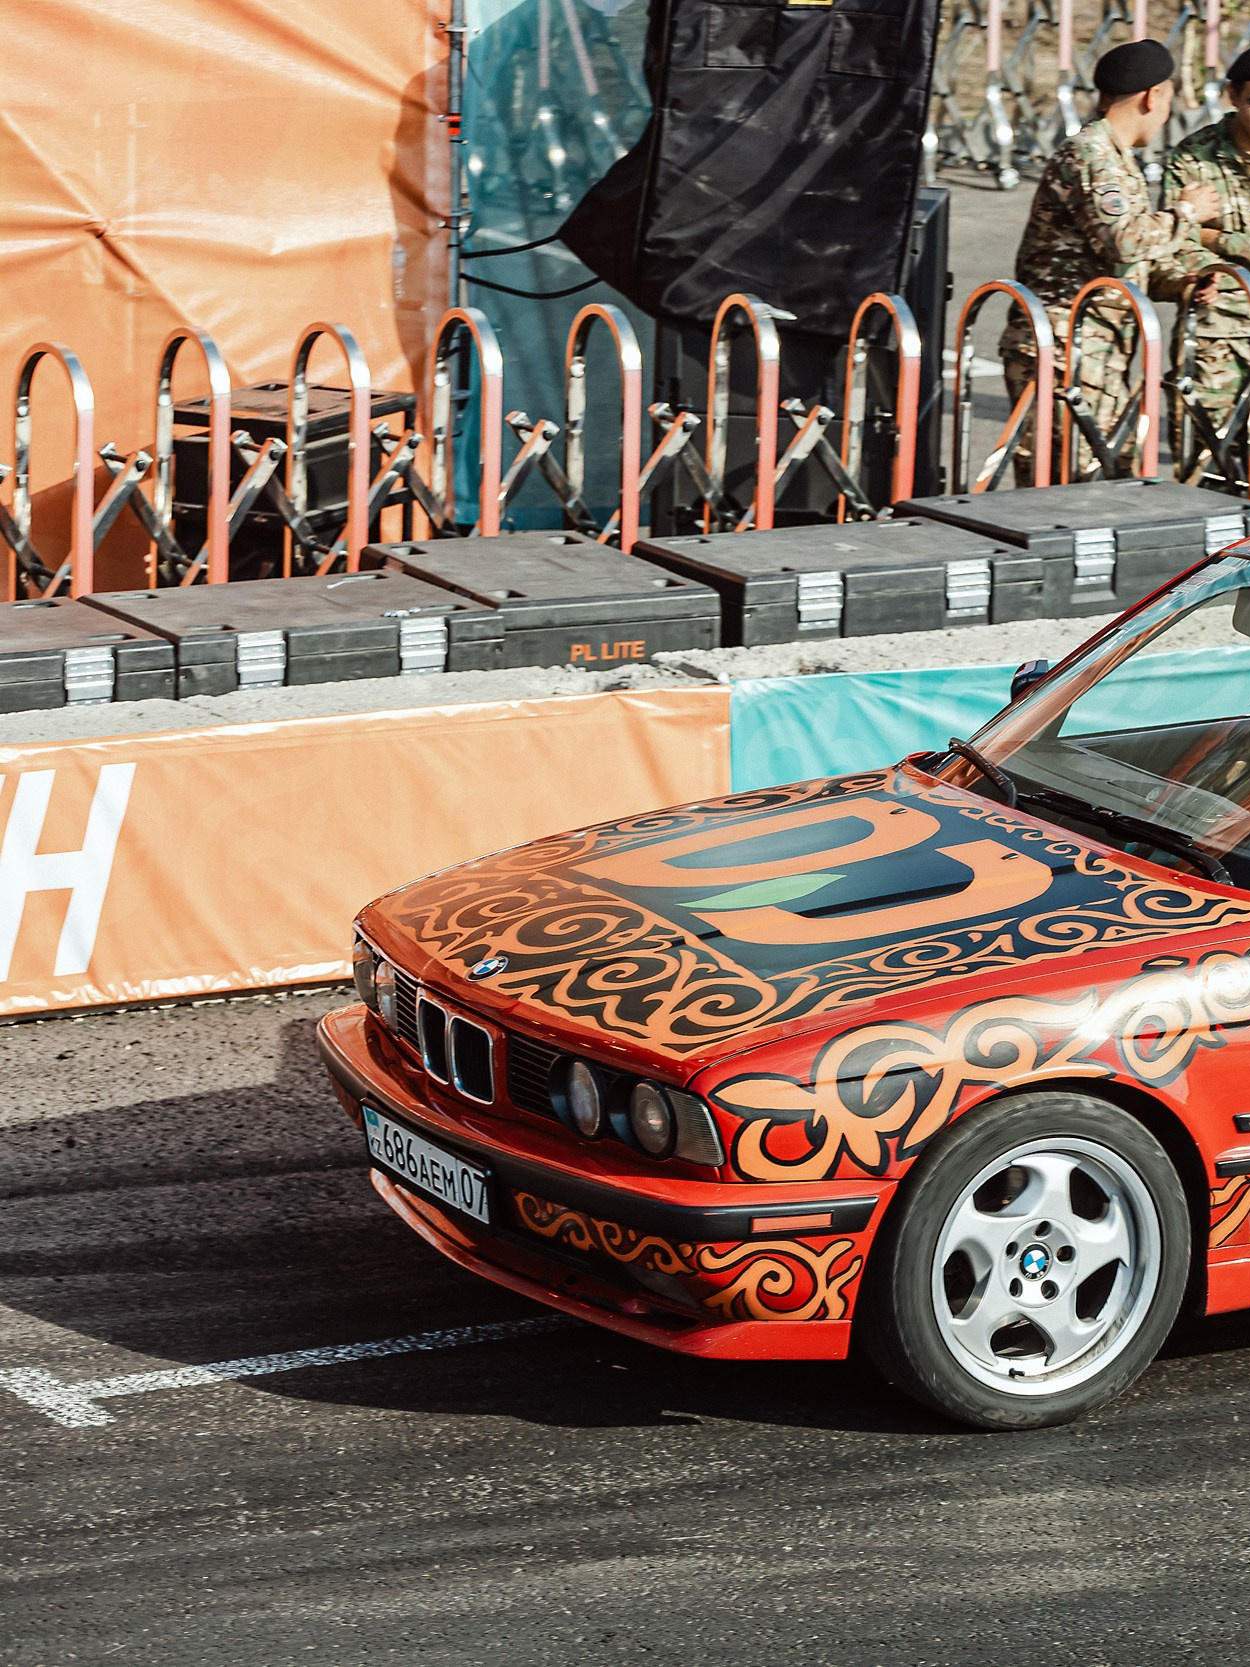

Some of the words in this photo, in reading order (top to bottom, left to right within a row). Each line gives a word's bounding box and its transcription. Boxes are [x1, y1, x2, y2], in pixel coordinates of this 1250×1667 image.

[570, 643, 598, 662] PL
[601, 640, 646, 660] LITE
[383, 1123, 457, 1202] 686AEM
[461, 1167, 488, 1216] 07
